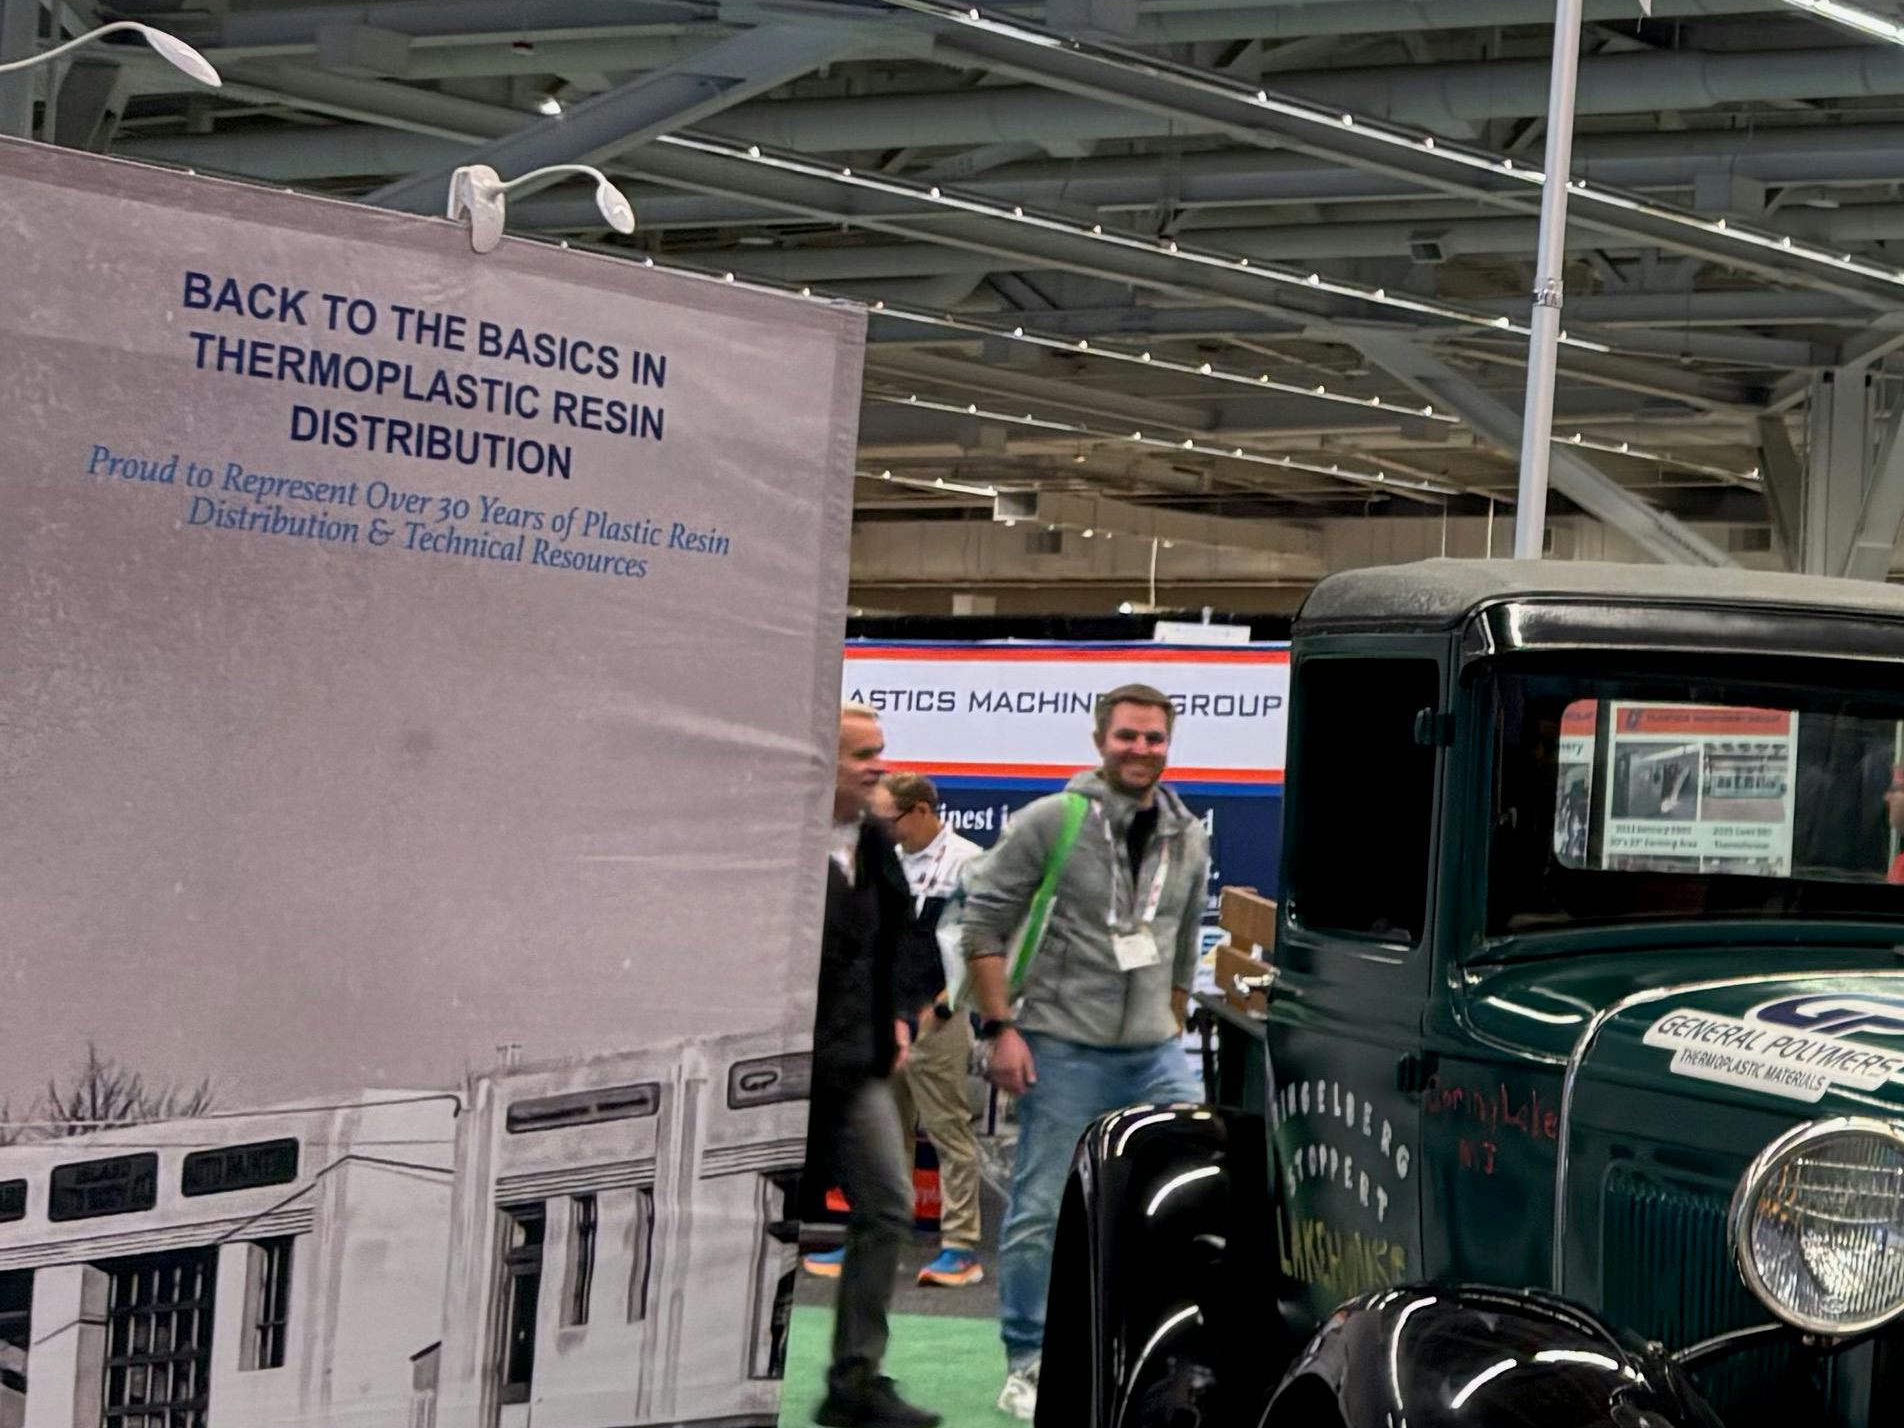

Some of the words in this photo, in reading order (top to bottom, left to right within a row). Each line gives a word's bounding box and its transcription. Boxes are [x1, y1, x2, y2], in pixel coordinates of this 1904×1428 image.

[183, 271, 308, 326] BACK
[323, 294, 377, 335] TO
[391, 306, 466, 352] THE
[478, 319, 619, 381] BASICS
[631, 350, 667, 388] IN
[190, 331, 540, 420] THERMOPLASTIC
[553, 392, 665, 441] RESIN
[290, 405, 572, 480] DISTRIBUTION
[86, 444, 177, 486] Proud
[187, 462, 213, 489] to
[221, 461, 359, 511] Represent
[367, 481, 432, 515] Over
[437, 495, 470, 524] 30
[479, 496, 544, 532] Years
[550, 506, 580, 540] of
[582, 509, 661, 549] Plastic
[668, 521, 732, 556] Resin
[188, 495, 360, 545] Distribution
[368, 519, 392, 546] &
[403, 521, 526, 566] Technical
[529, 538, 648, 580] Resources
[968, 690, 1108, 715] MACHIN
[1174, 694, 1282, 719] GROUP
[938, 805, 994, 832] inest
[1657, 1014, 1764, 1052] GENERAL
[1766, 1036, 1903, 1078] POLYMERS
[1680, 1048, 1763, 1080] THERMOPLASTIC
[1763, 1064, 1827, 1092] MATERIALS
